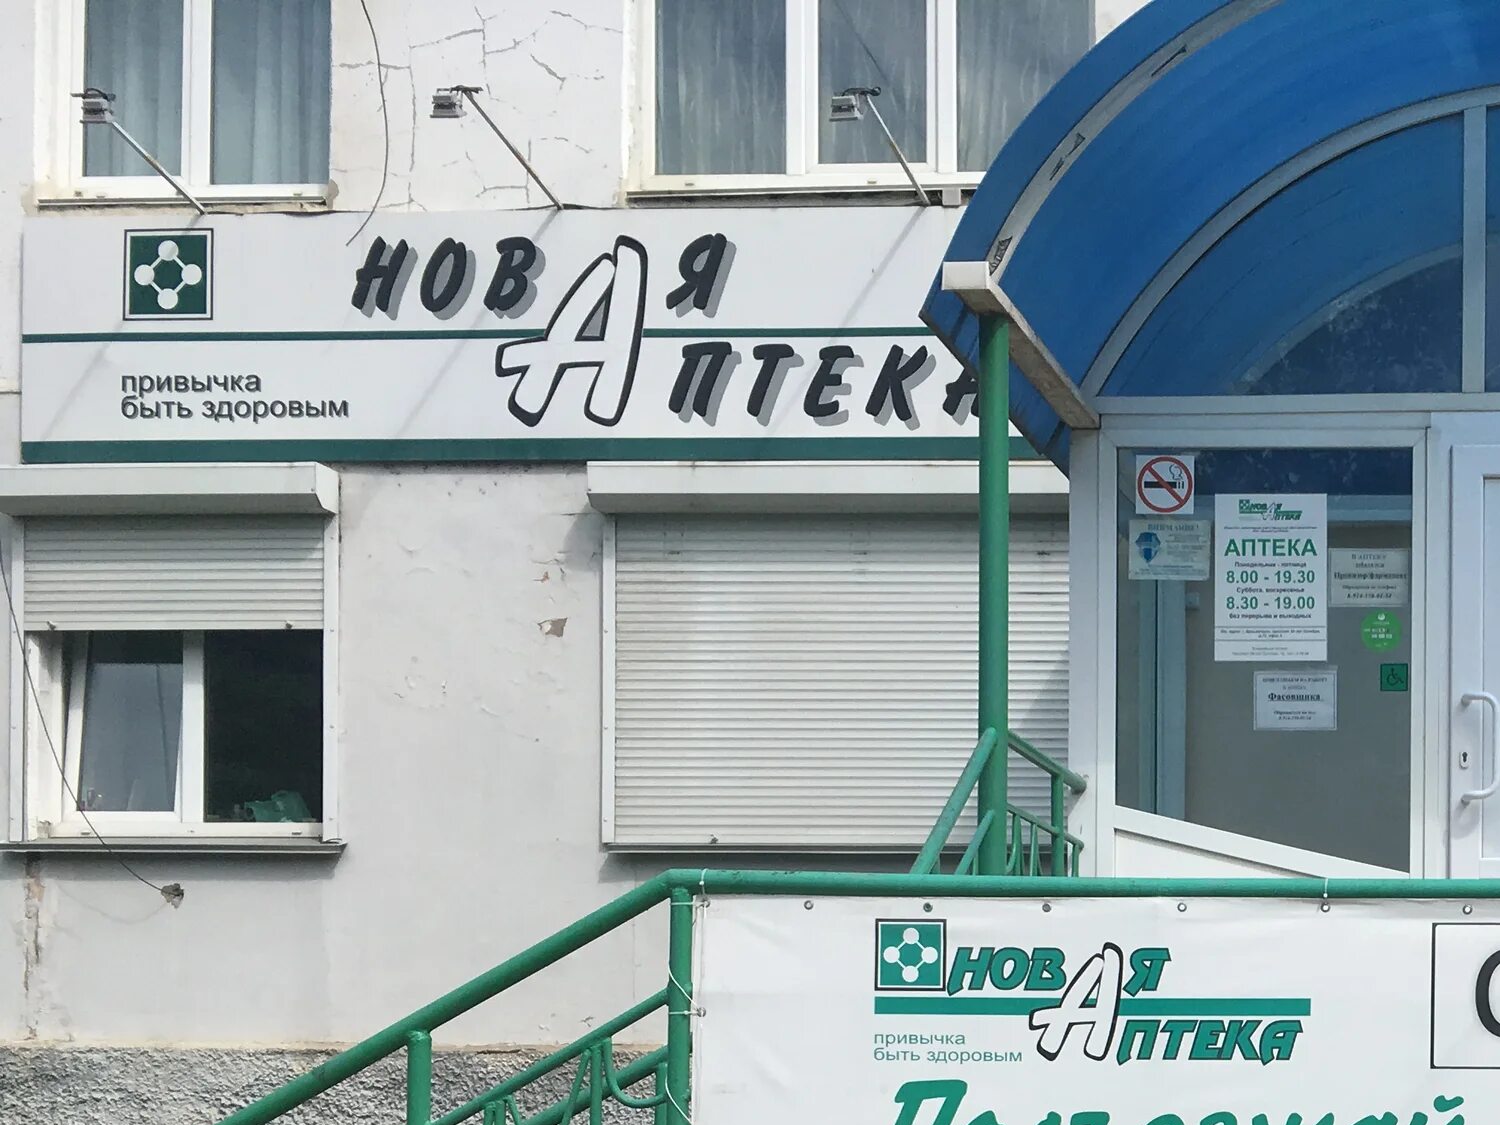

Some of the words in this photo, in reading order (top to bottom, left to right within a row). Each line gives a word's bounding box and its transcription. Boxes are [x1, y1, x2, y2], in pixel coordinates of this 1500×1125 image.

[121, 374, 262, 397] привычка
[121, 394, 193, 420] быть
[201, 399, 349, 425] здоровым
[1224, 538, 1317, 556] АПТЕКА
[1226, 570, 1258, 583] 8.00
[1275, 570, 1315, 583] 19.30
[1226, 596, 1258, 609] 8.30
[1275, 596, 1315, 609] 19.00
[873, 1033, 966, 1047] привычка
[873, 1046, 921, 1062] быть
[927, 1049, 1023, 1064] здоровым
